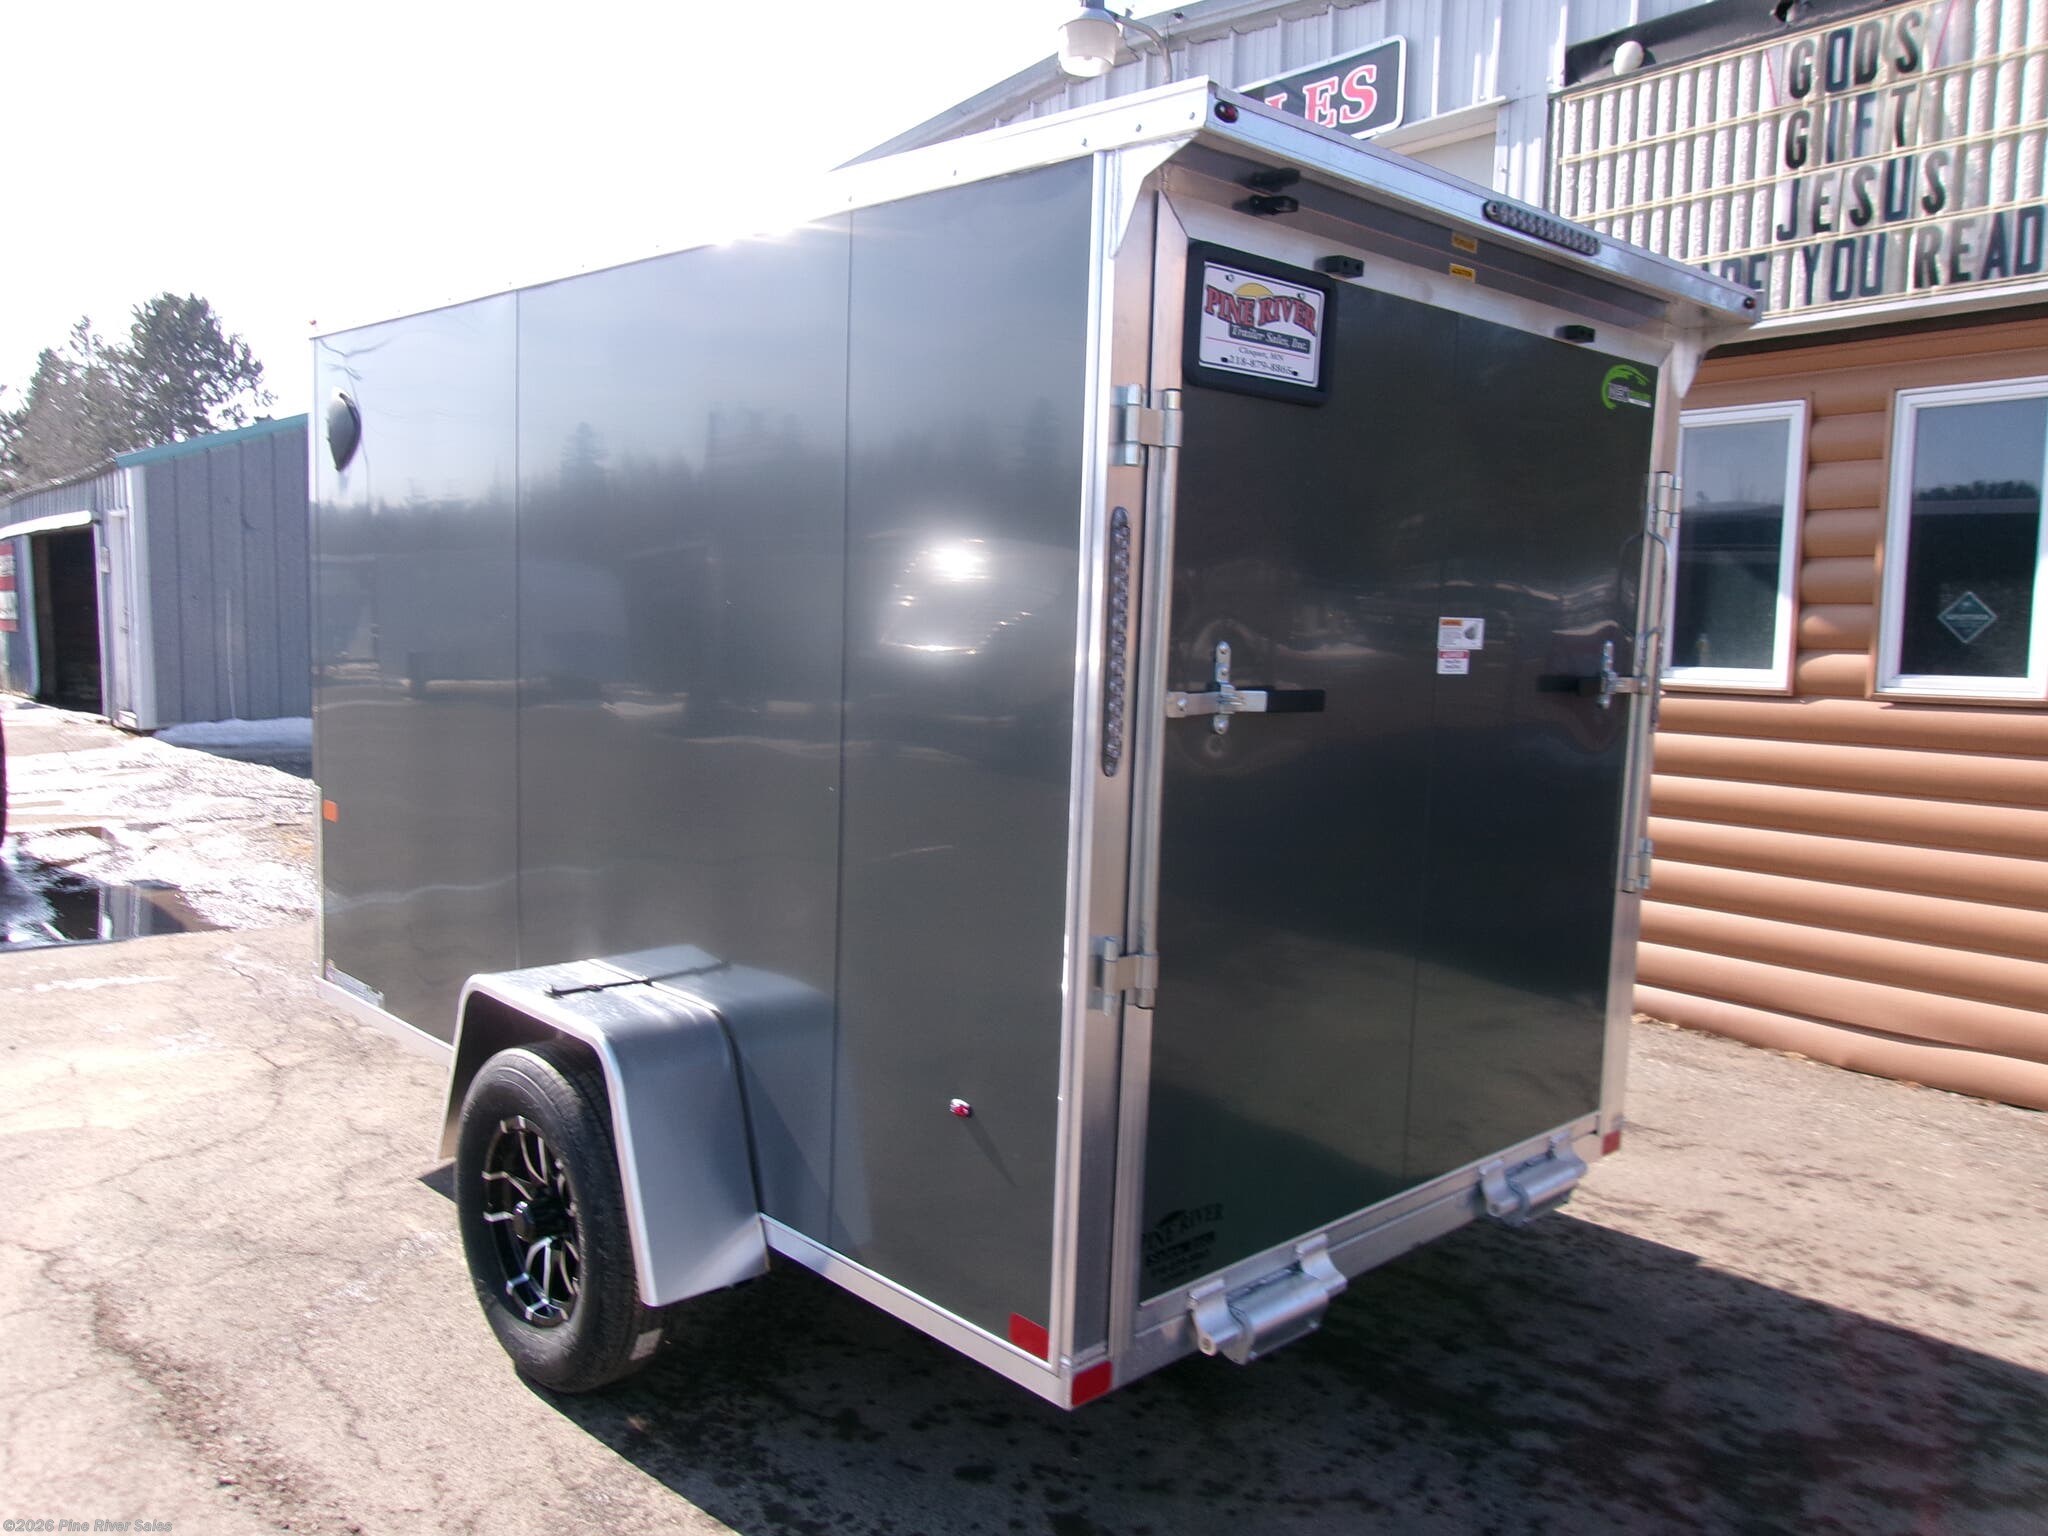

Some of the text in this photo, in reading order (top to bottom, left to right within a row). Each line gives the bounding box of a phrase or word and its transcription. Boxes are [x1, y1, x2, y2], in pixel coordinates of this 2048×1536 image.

[1776, 151, 1949, 241] JESUS
[1803, 232, 1887, 305] YOU
[1205, 284, 1317, 337] PINE RIVER
